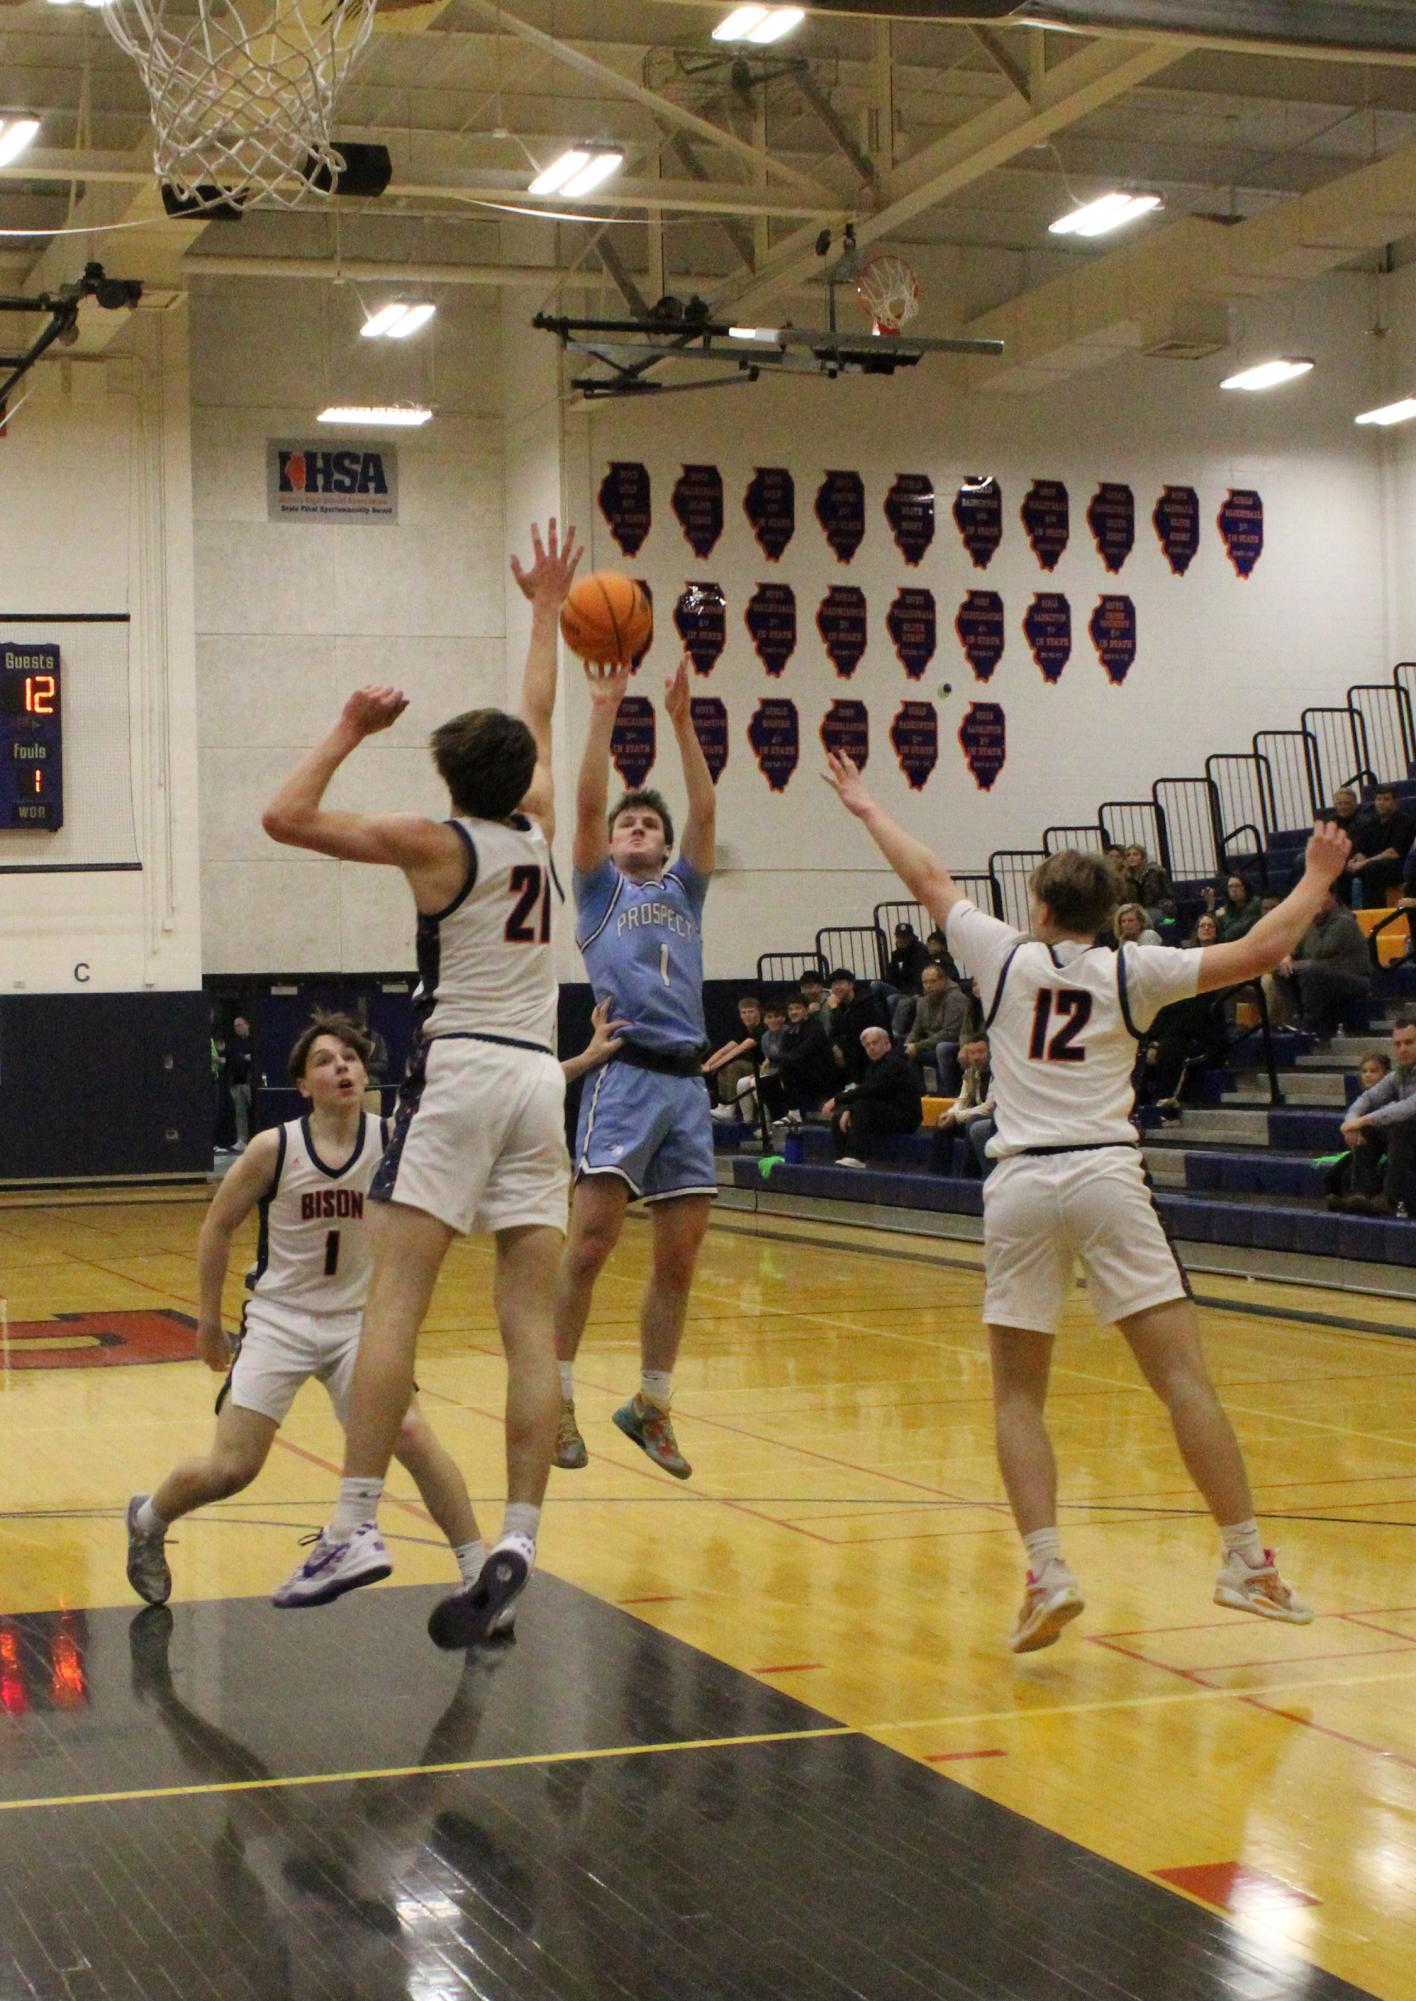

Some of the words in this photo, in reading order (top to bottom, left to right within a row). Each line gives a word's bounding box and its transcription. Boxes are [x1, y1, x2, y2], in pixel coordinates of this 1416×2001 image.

[278, 451, 388, 494] IHSA
[5, 652, 54, 670] Guests
[25, 676, 55, 713] 12
[35, 769, 41, 792] 1
[504, 864, 551, 944] 21
[616, 902, 692, 942] PROSPECT
[74, 962, 91, 983] C
[660, 943, 670, 987] 1
[1028, 987, 1093, 1062] 12
[302, 1190, 364, 1220] BISON
[324, 1230, 341, 1276] 1
